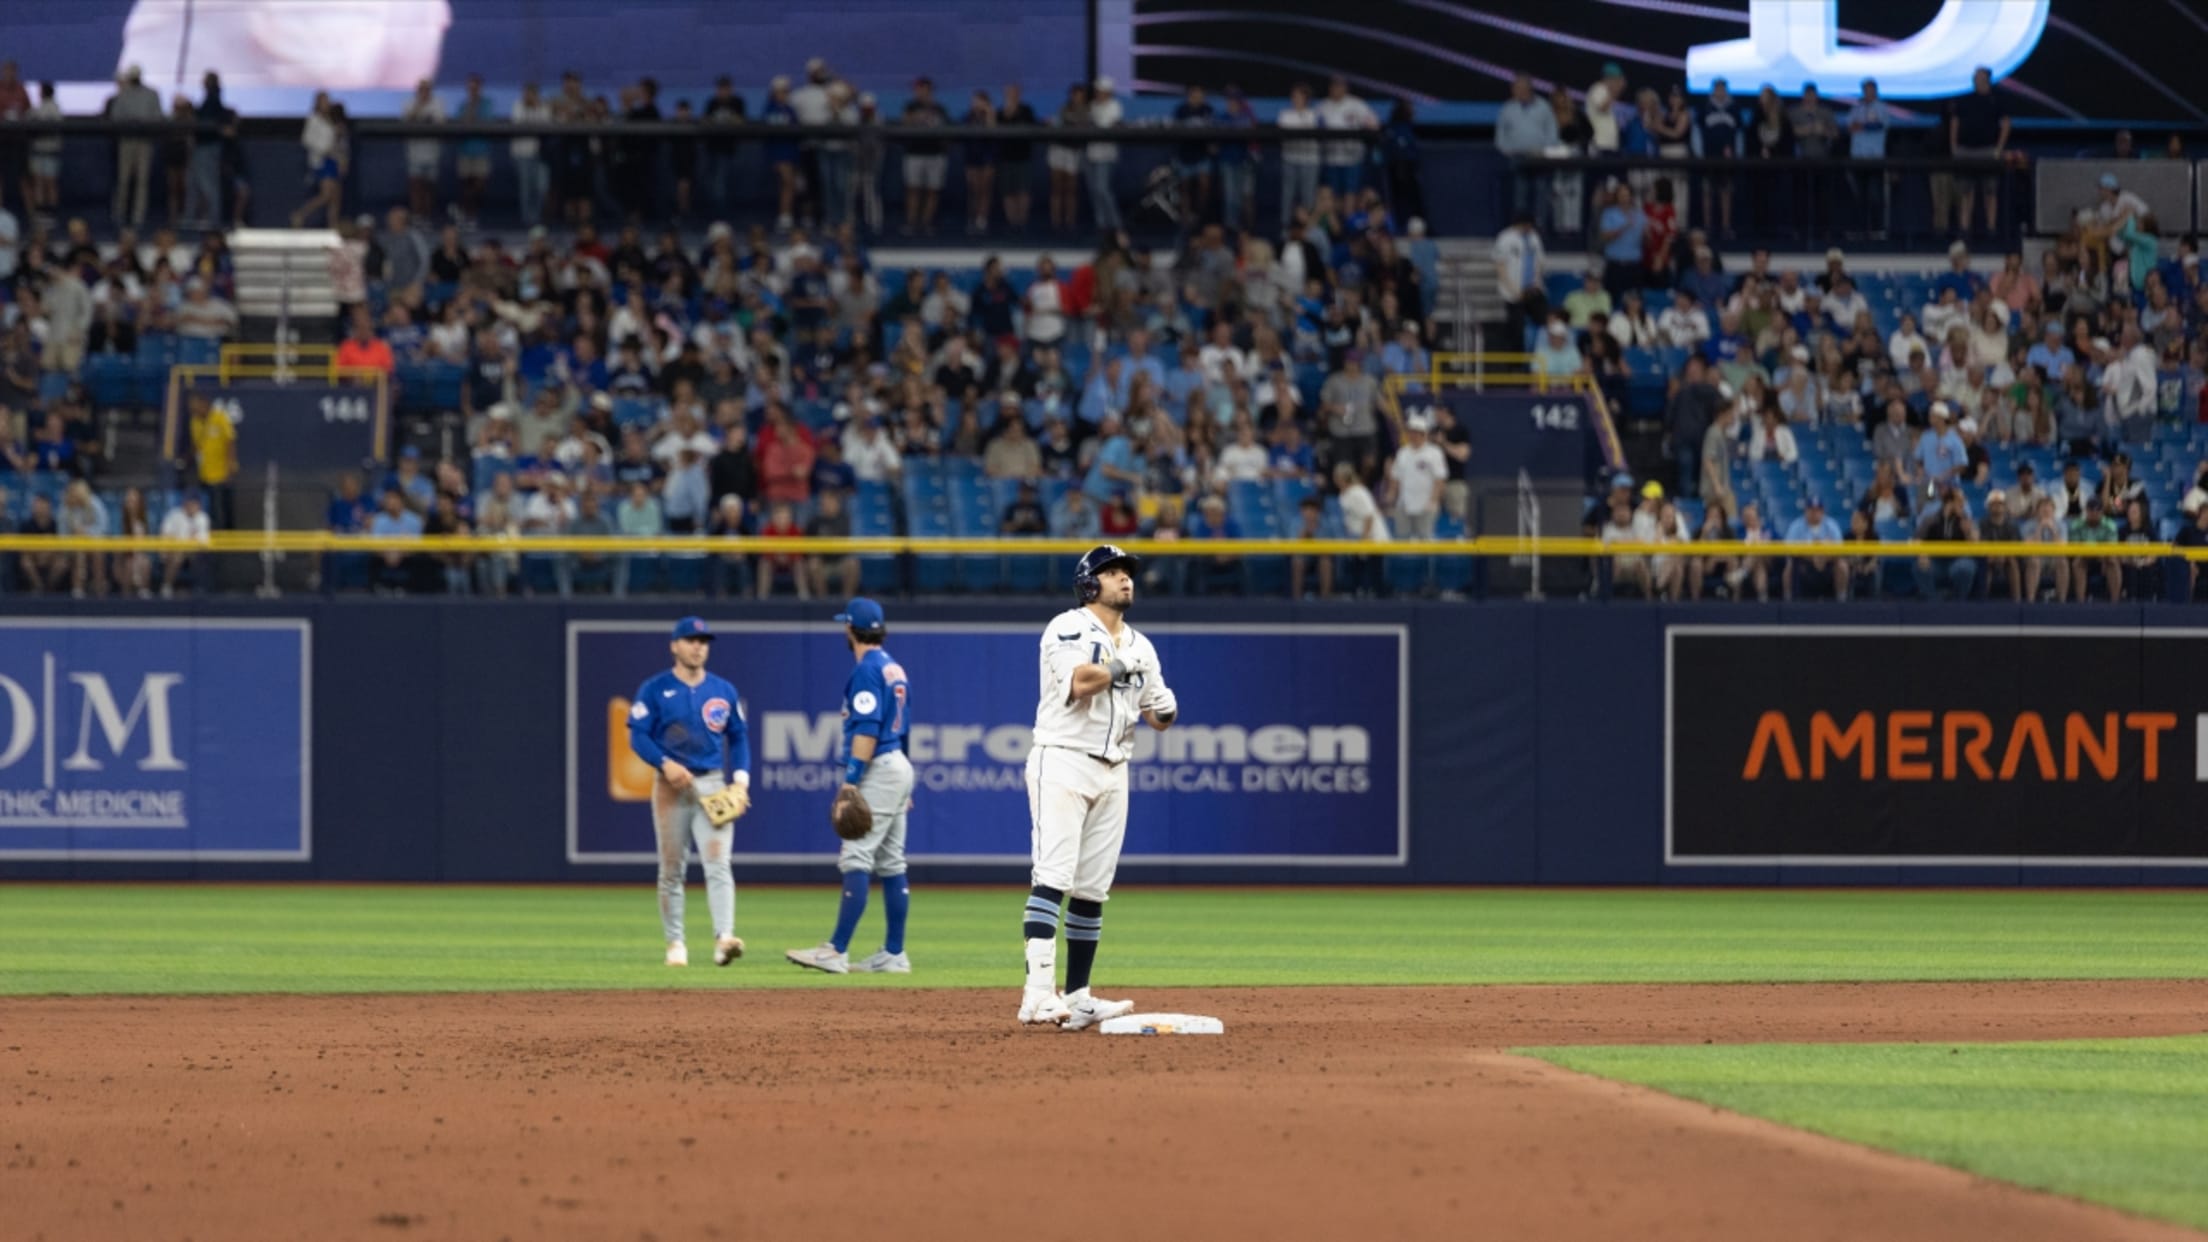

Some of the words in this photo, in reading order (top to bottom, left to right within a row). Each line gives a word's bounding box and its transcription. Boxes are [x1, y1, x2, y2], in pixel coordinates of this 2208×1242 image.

[319, 396, 368, 423] 144
[1530, 404, 1580, 430] 142
[1742, 710, 2177, 781] AMERANT
[1242, 766, 1370, 792] DEVICES
[55, 789, 183, 817] MEDICINE
